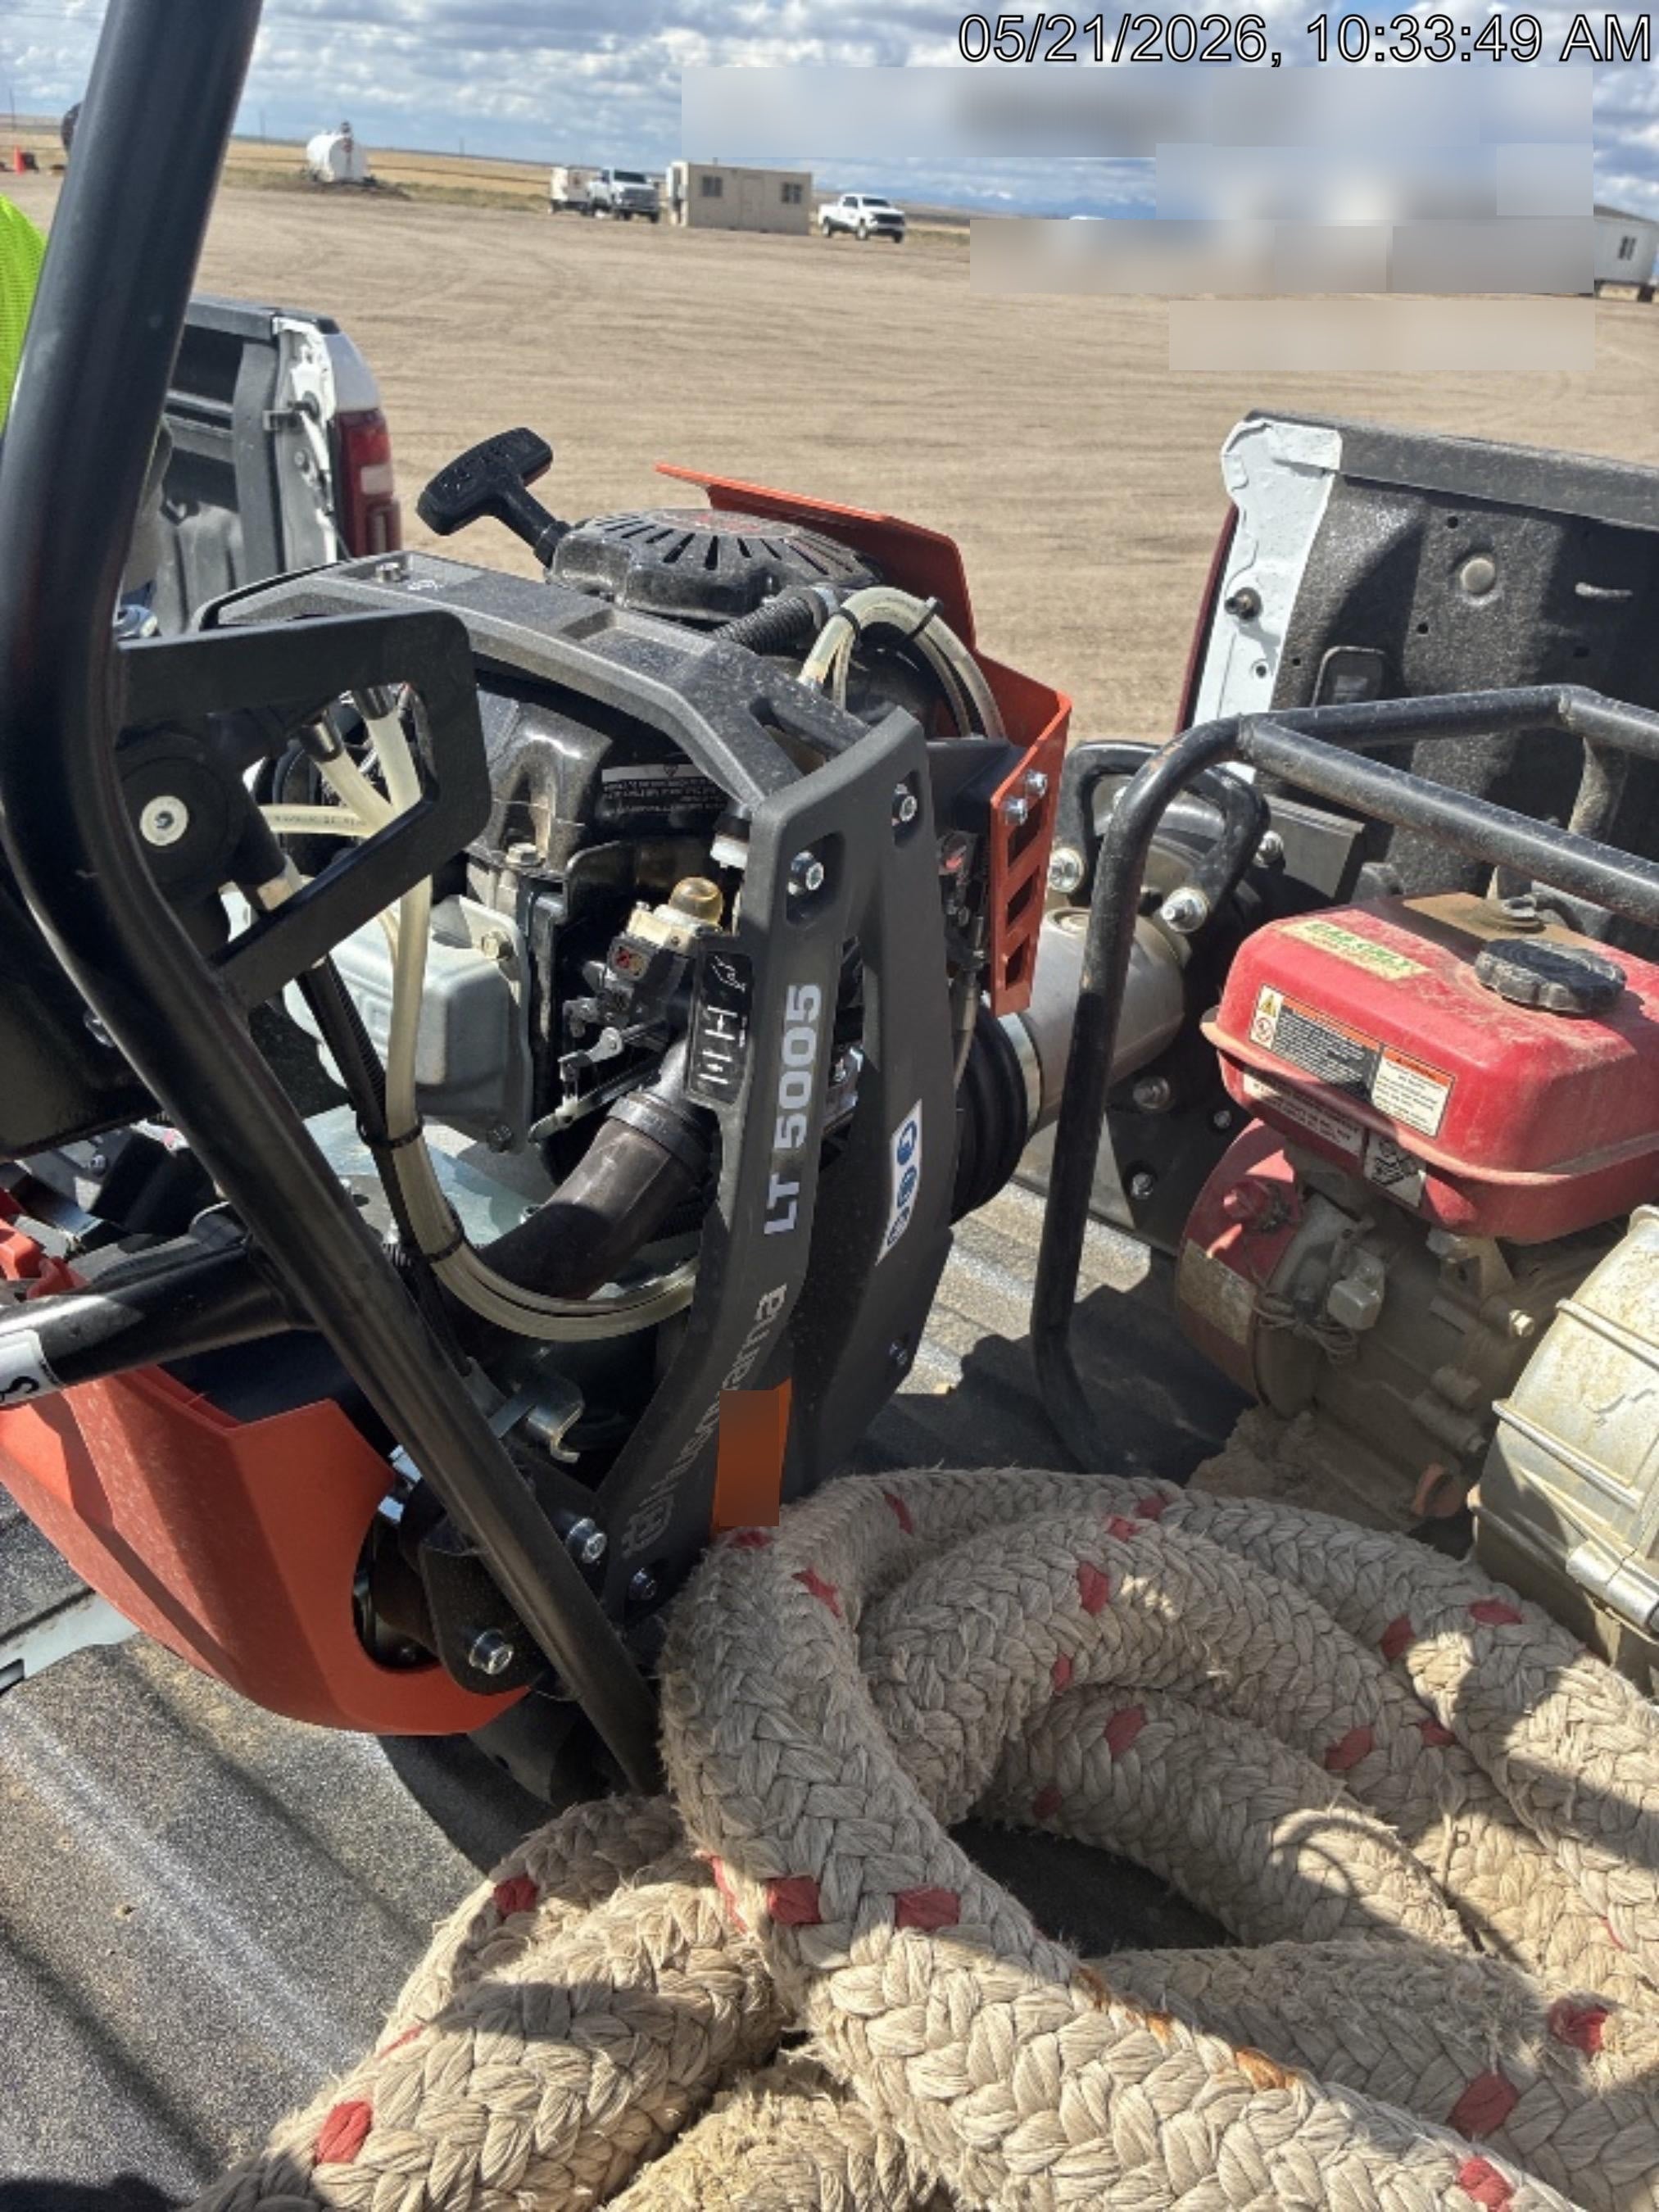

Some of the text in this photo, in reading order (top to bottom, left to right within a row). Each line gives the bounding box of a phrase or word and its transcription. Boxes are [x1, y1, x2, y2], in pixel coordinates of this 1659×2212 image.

[764, 984, 822, 1235] LT 5005
[637, 1283, 788, 1509] Husqarna
